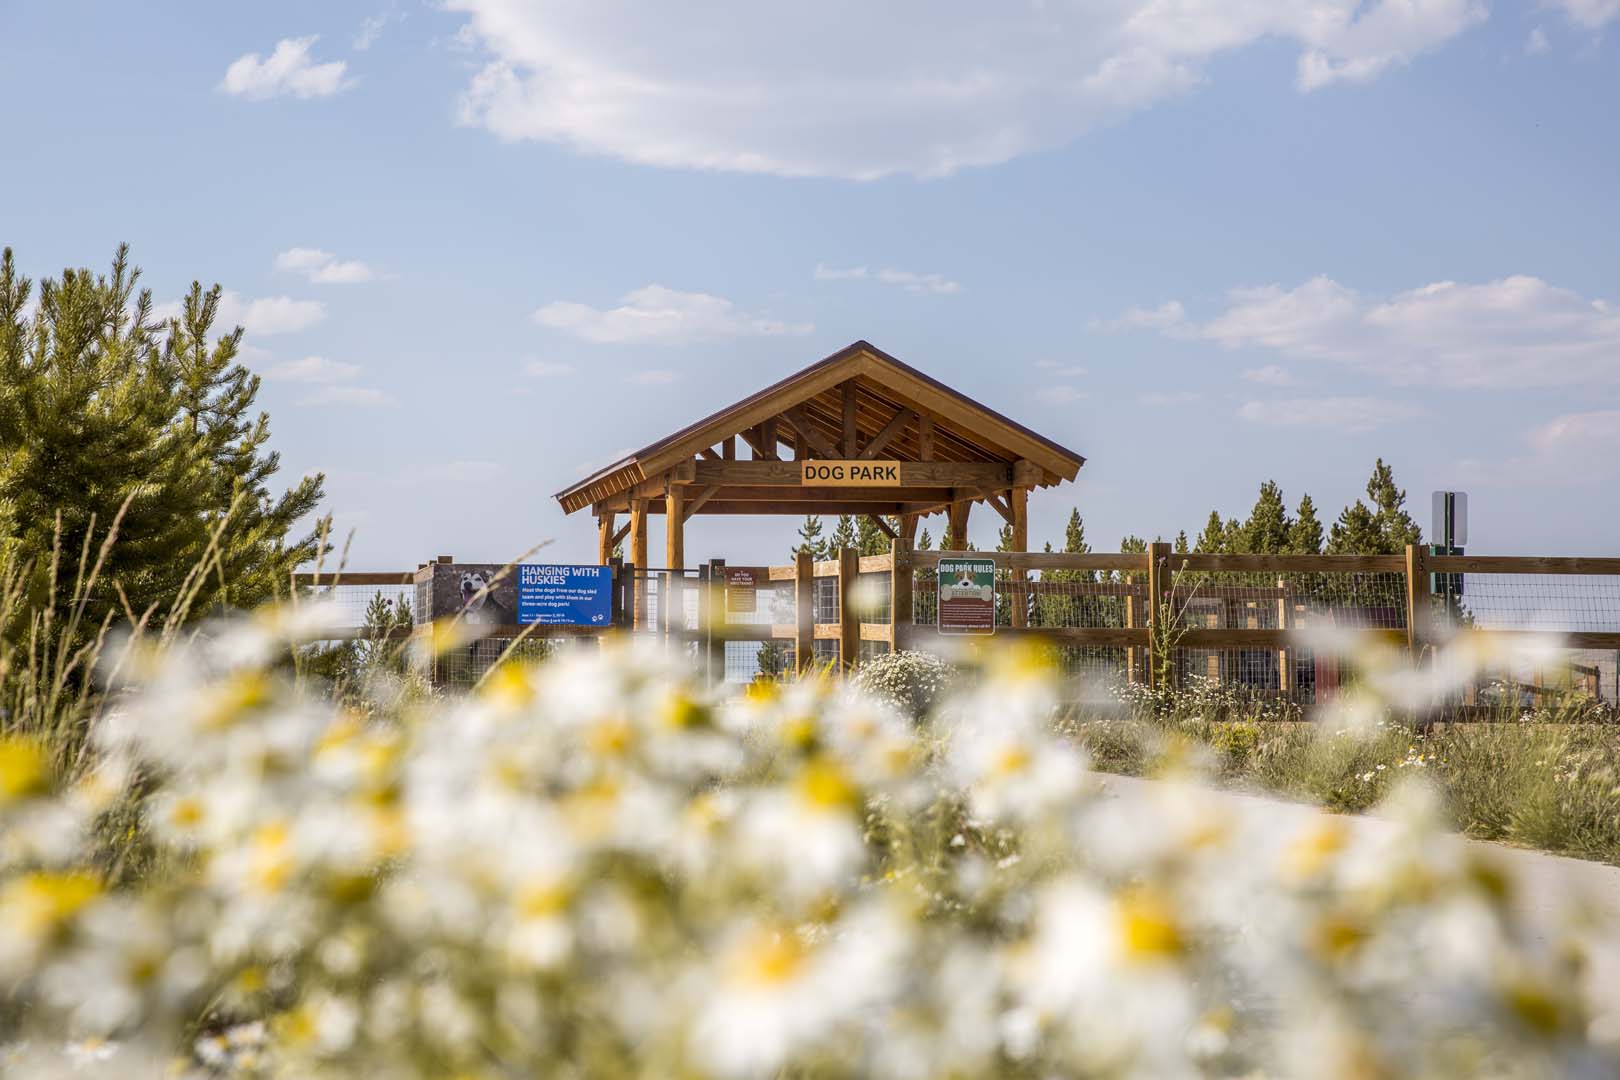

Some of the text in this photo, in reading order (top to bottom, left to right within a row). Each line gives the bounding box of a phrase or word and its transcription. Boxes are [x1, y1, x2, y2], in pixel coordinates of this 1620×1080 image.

[805, 466, 897, 480] DOG PARK
[521, 566, 600, 577] HANGING WITH
[940, 564, 993, 574] DOG PARK RULES
[521, 575, 566, 585] HUSKIES
